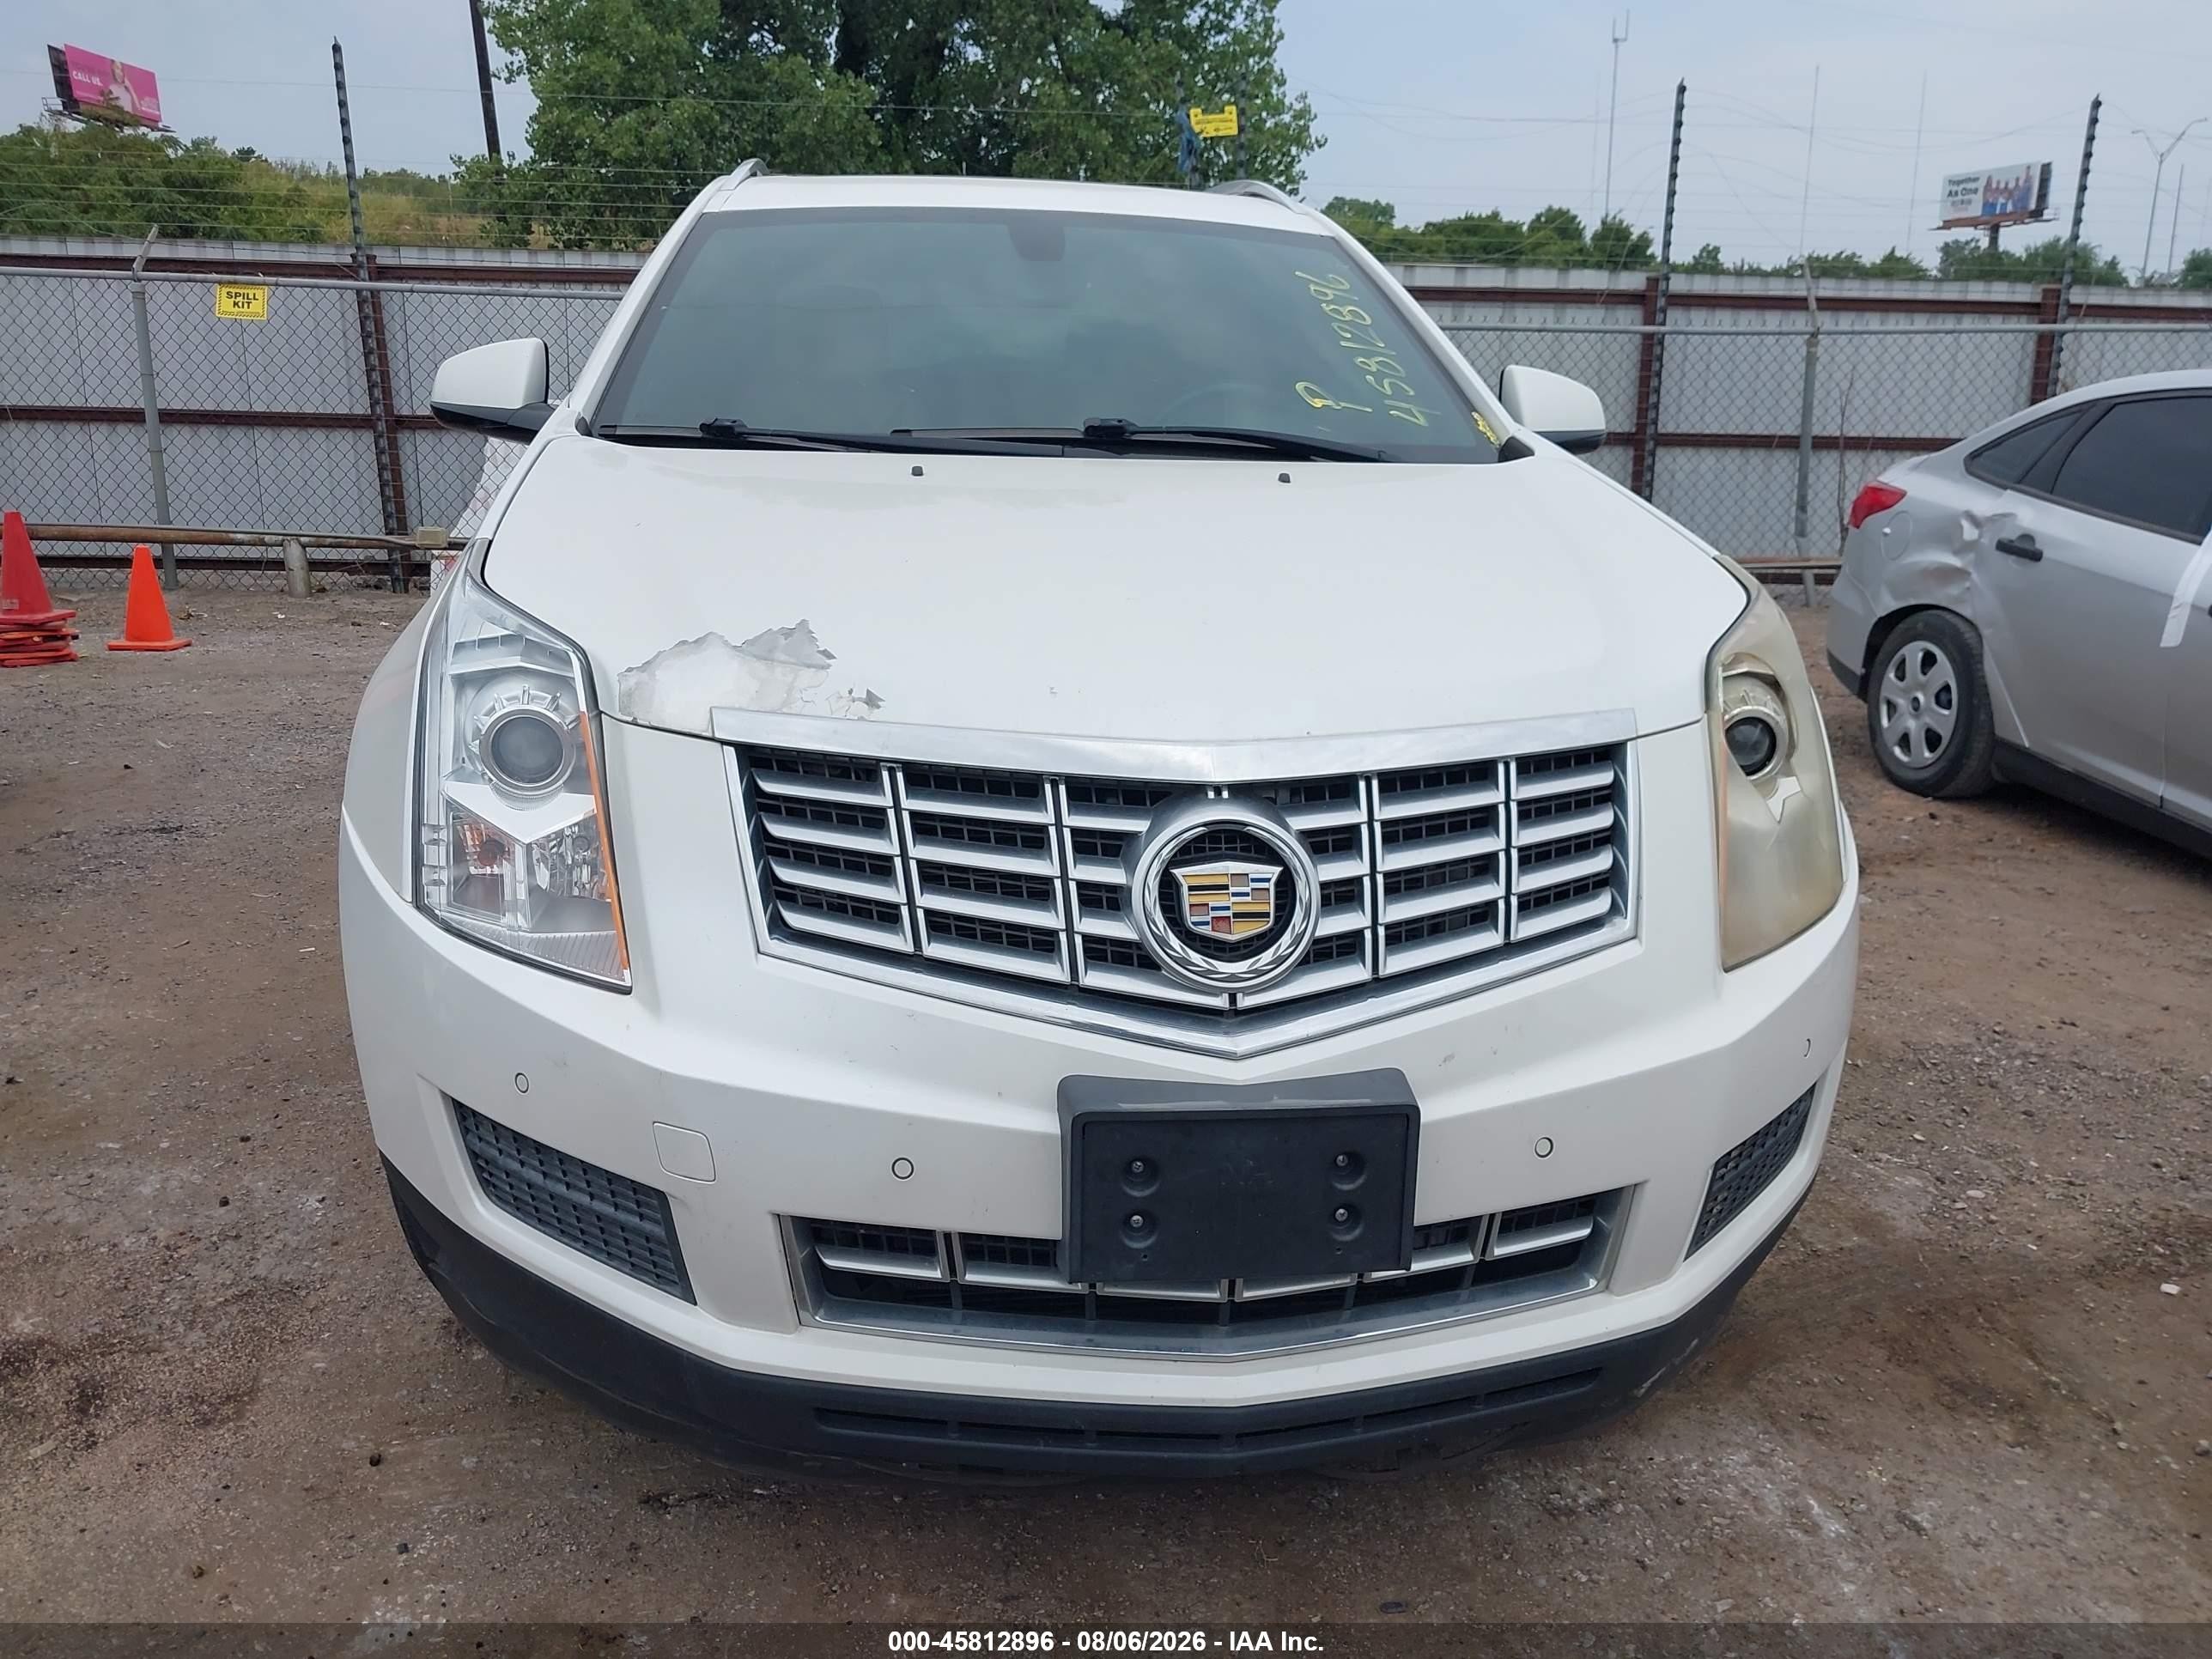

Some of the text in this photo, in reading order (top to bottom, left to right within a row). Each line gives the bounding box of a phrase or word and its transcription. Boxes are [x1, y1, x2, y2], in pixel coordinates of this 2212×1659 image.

[72, 70, 91, 82] CALL
[1947, 186, 1978, 198] As One
[226, 291, 258, 301] SPILL
[233, 301, 252, 309] KIT
[1295, 271, 1442, 426] 45812896
